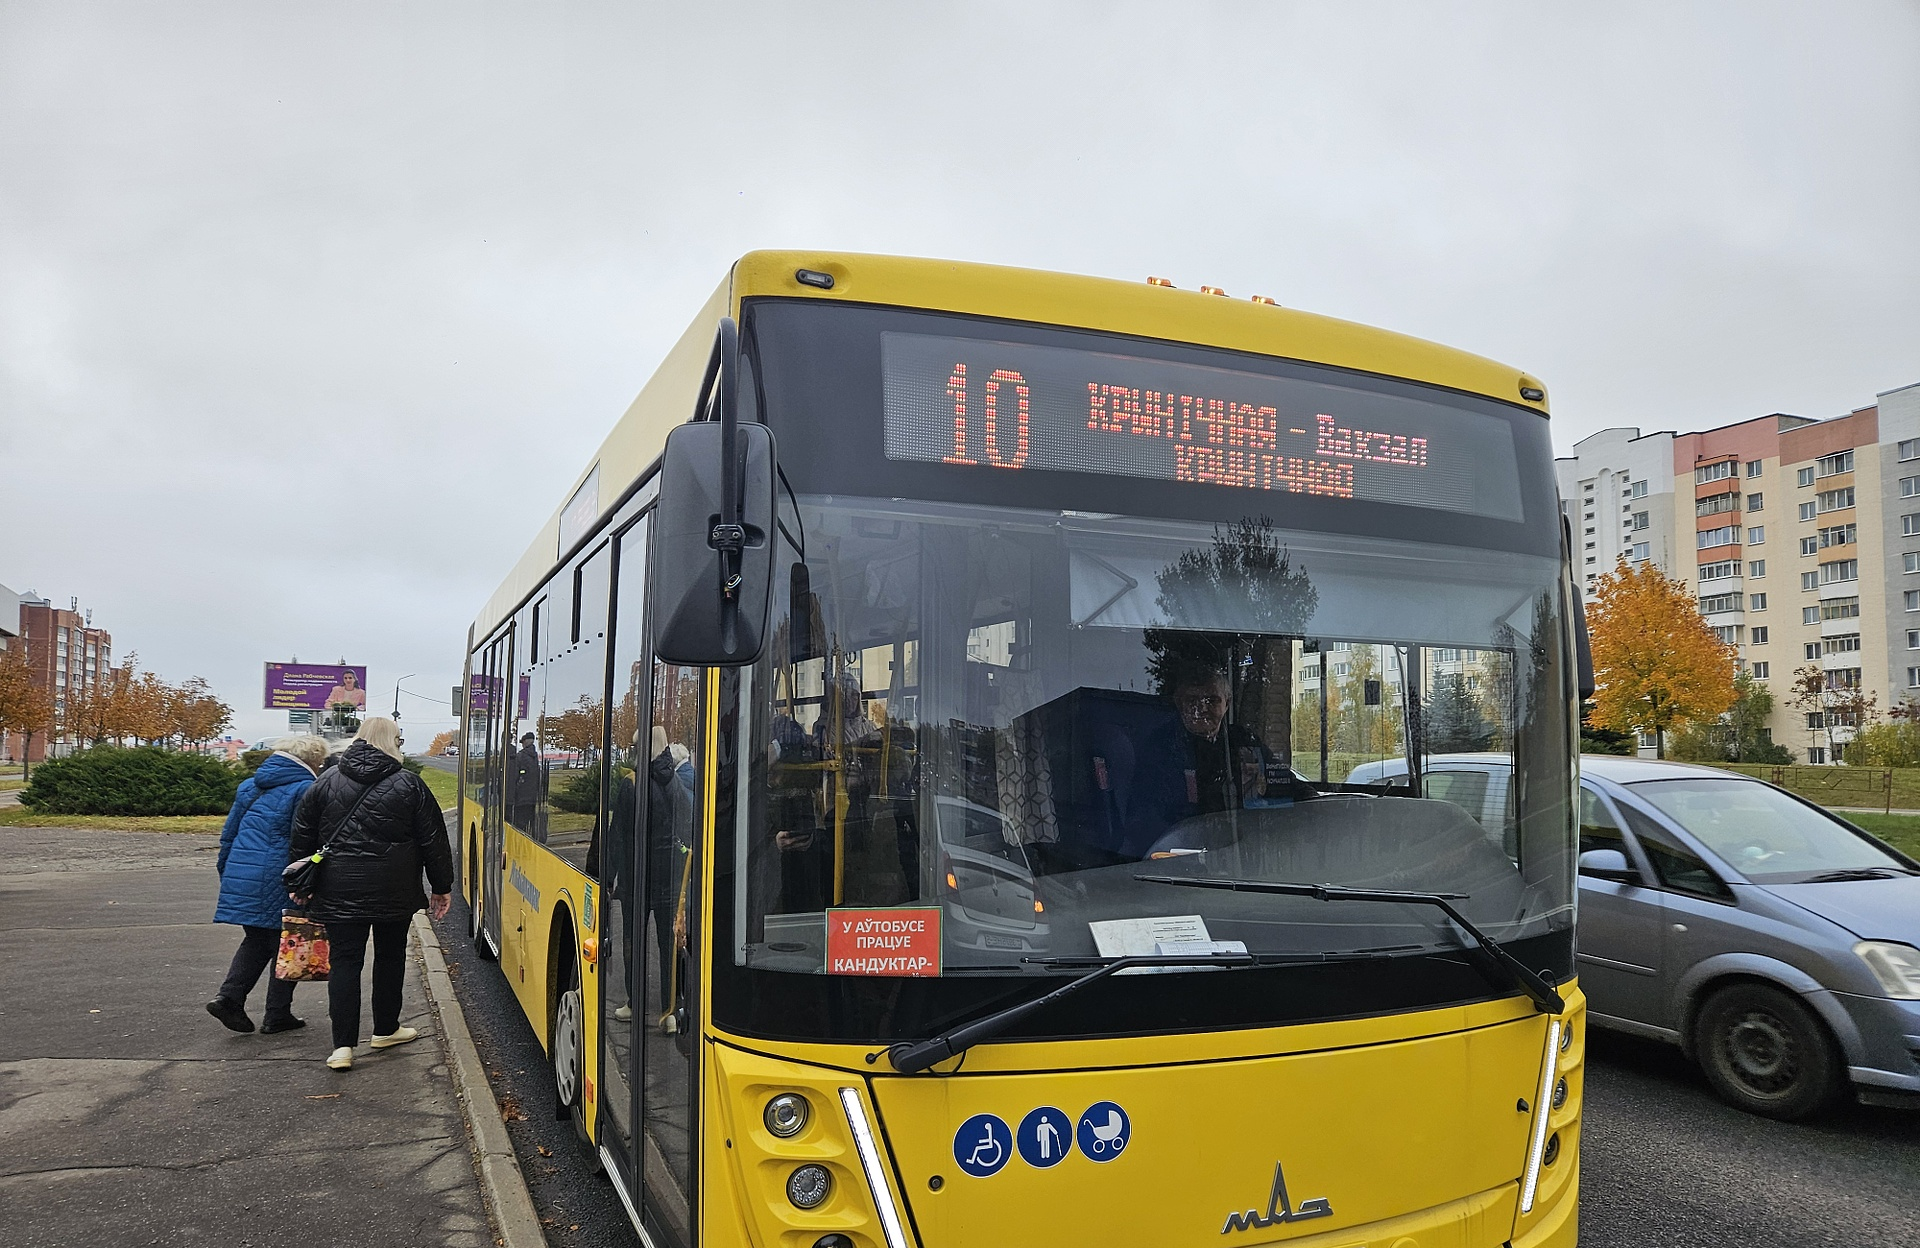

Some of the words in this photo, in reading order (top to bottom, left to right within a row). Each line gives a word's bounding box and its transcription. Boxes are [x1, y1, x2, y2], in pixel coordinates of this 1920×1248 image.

[943, 363, 1029, 469] 10
[1316, 413, 1428, 467] Вакзал
[843, 921, 852, 933] У
[855, 918, 925, 933] АЎТОБУСЕ
[856, 936, 911, 951] ПРАЦУЕ
